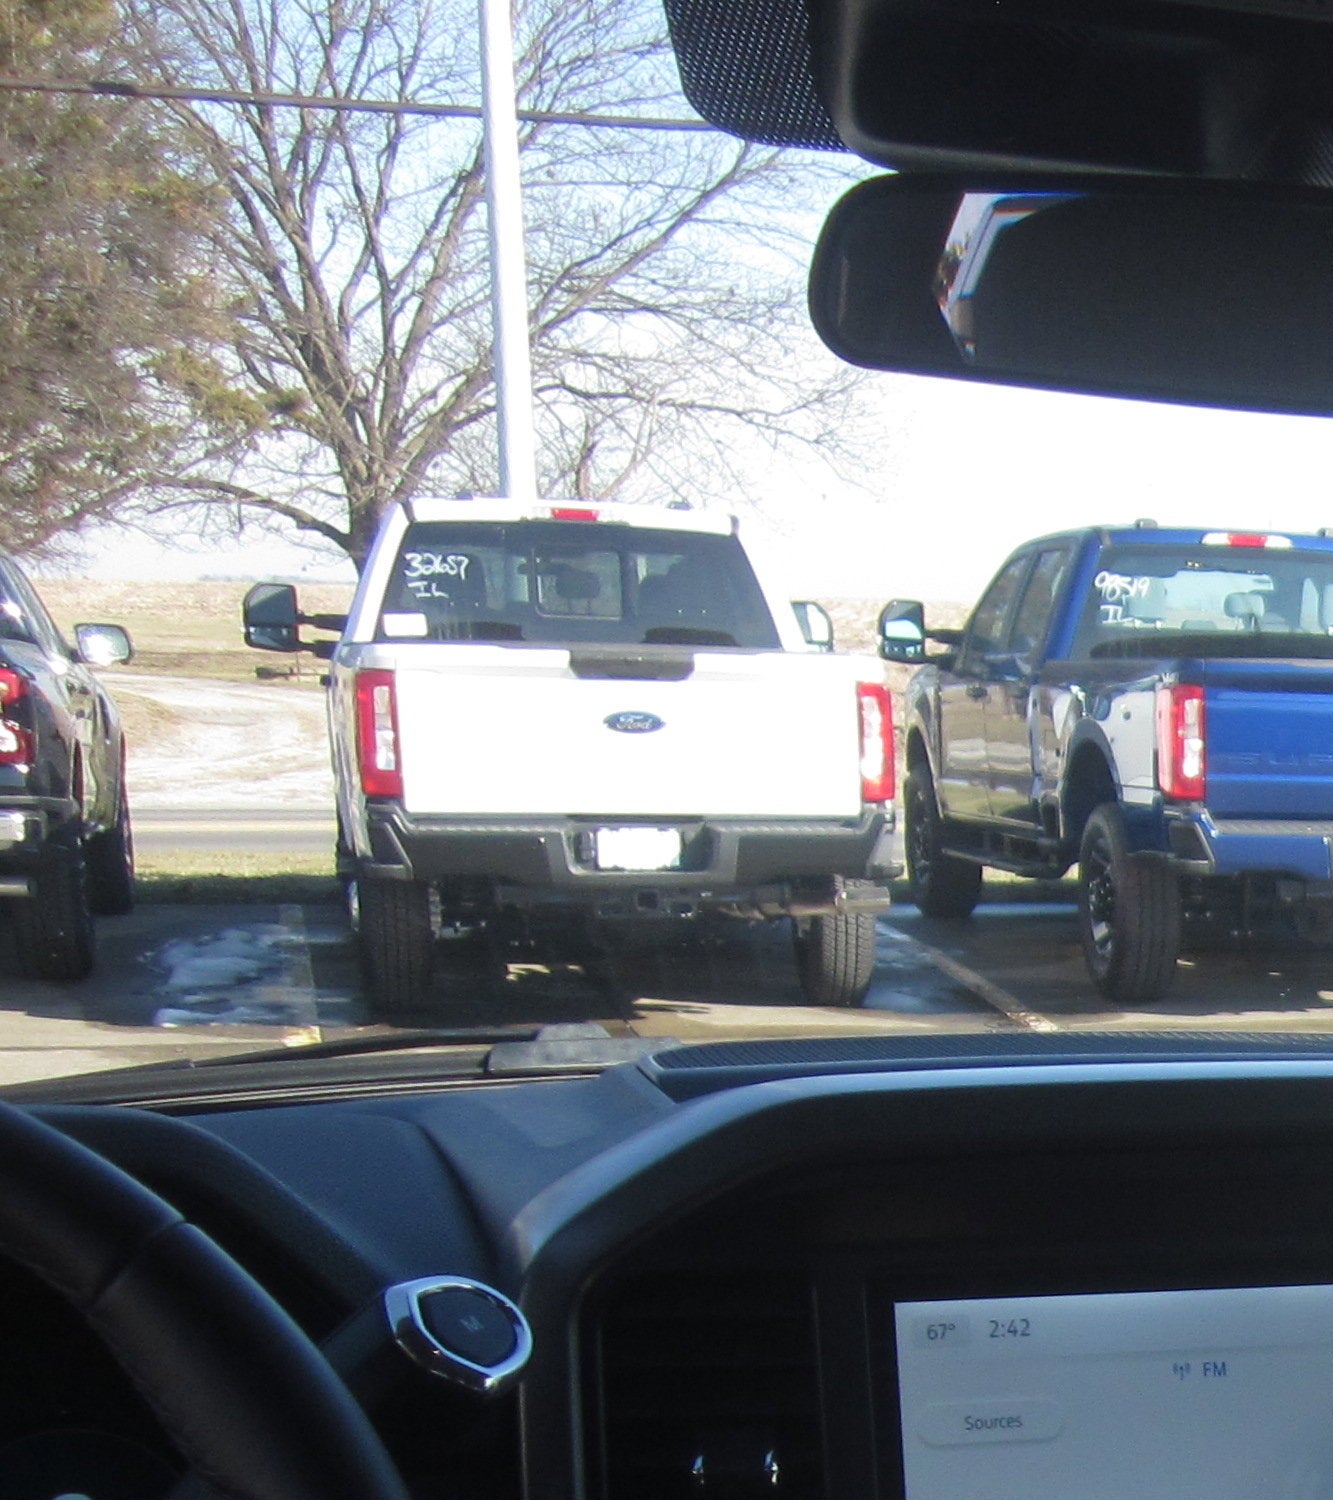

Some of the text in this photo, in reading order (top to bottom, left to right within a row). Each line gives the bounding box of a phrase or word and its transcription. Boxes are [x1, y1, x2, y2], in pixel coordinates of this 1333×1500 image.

[926, 1321, 956, 1341] 67°
[988, 1318, 1031, 1338] 2:42
[1202, 1361, 1227, 1378] FM
[964, 1413, 1023, 1432] Sources
